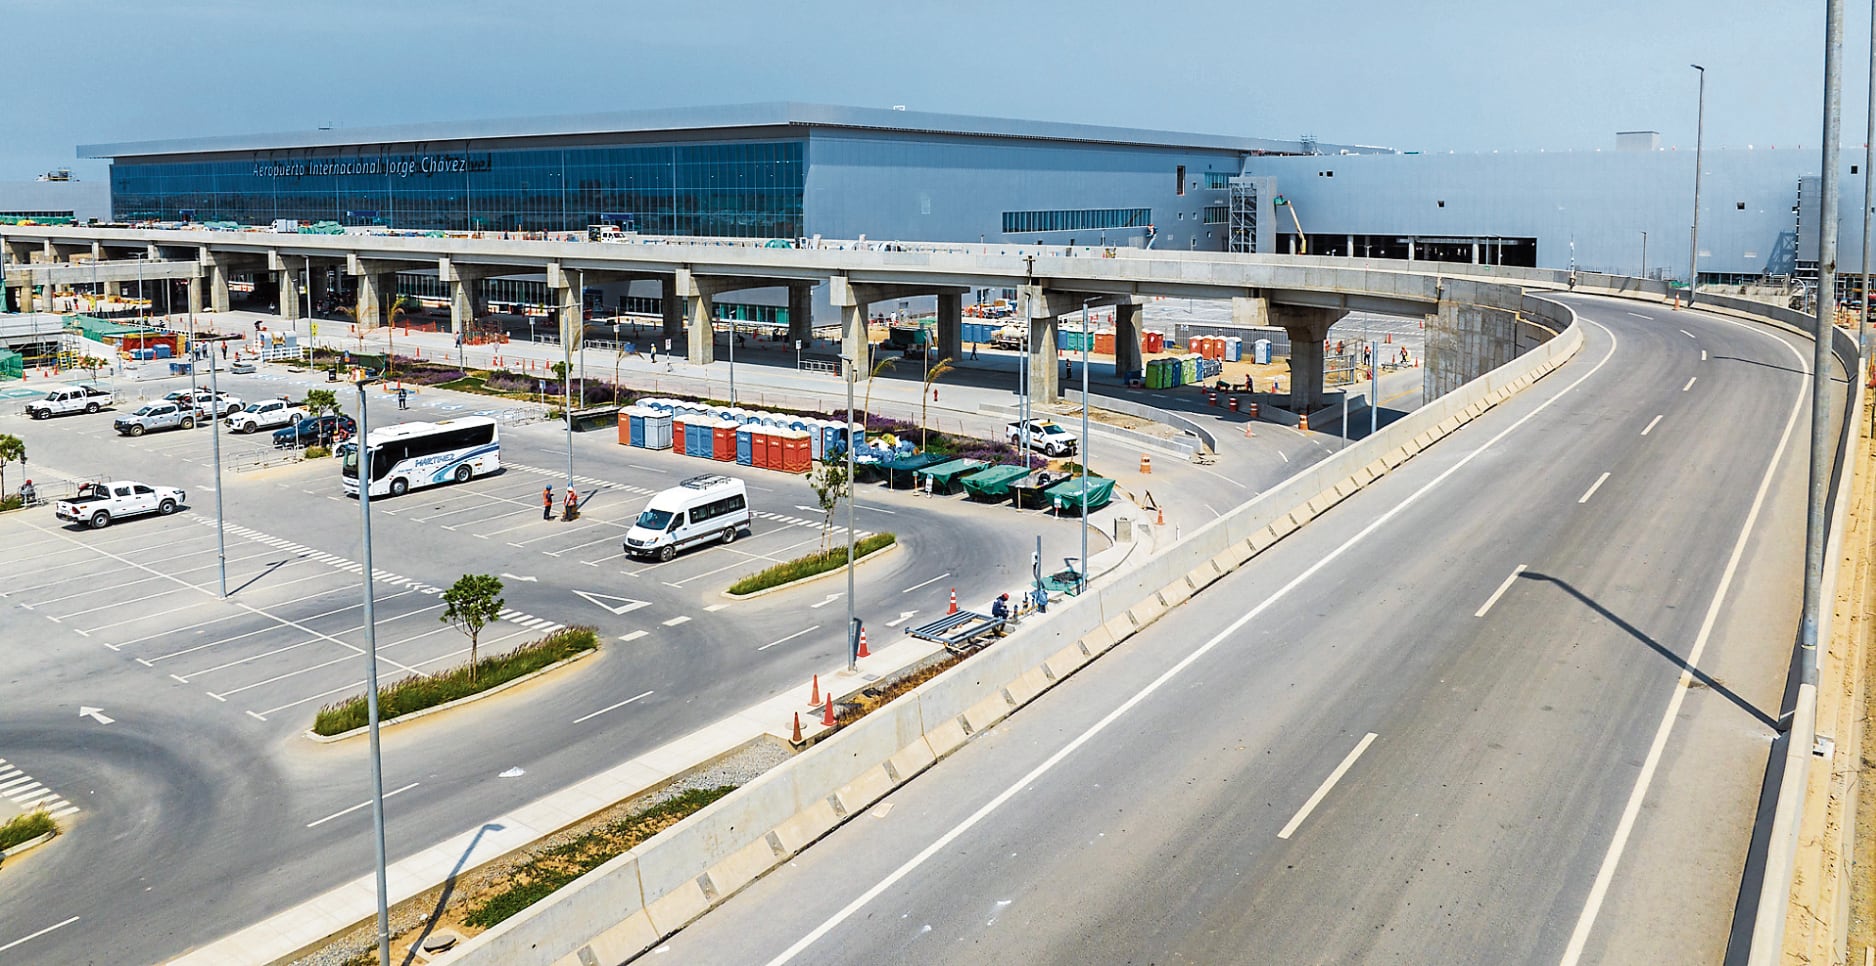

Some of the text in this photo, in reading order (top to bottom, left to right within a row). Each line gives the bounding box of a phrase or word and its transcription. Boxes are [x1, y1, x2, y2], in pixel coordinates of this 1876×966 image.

[253, 155, 467, 178] Aeropuerto Internacional Jorge Chávez
